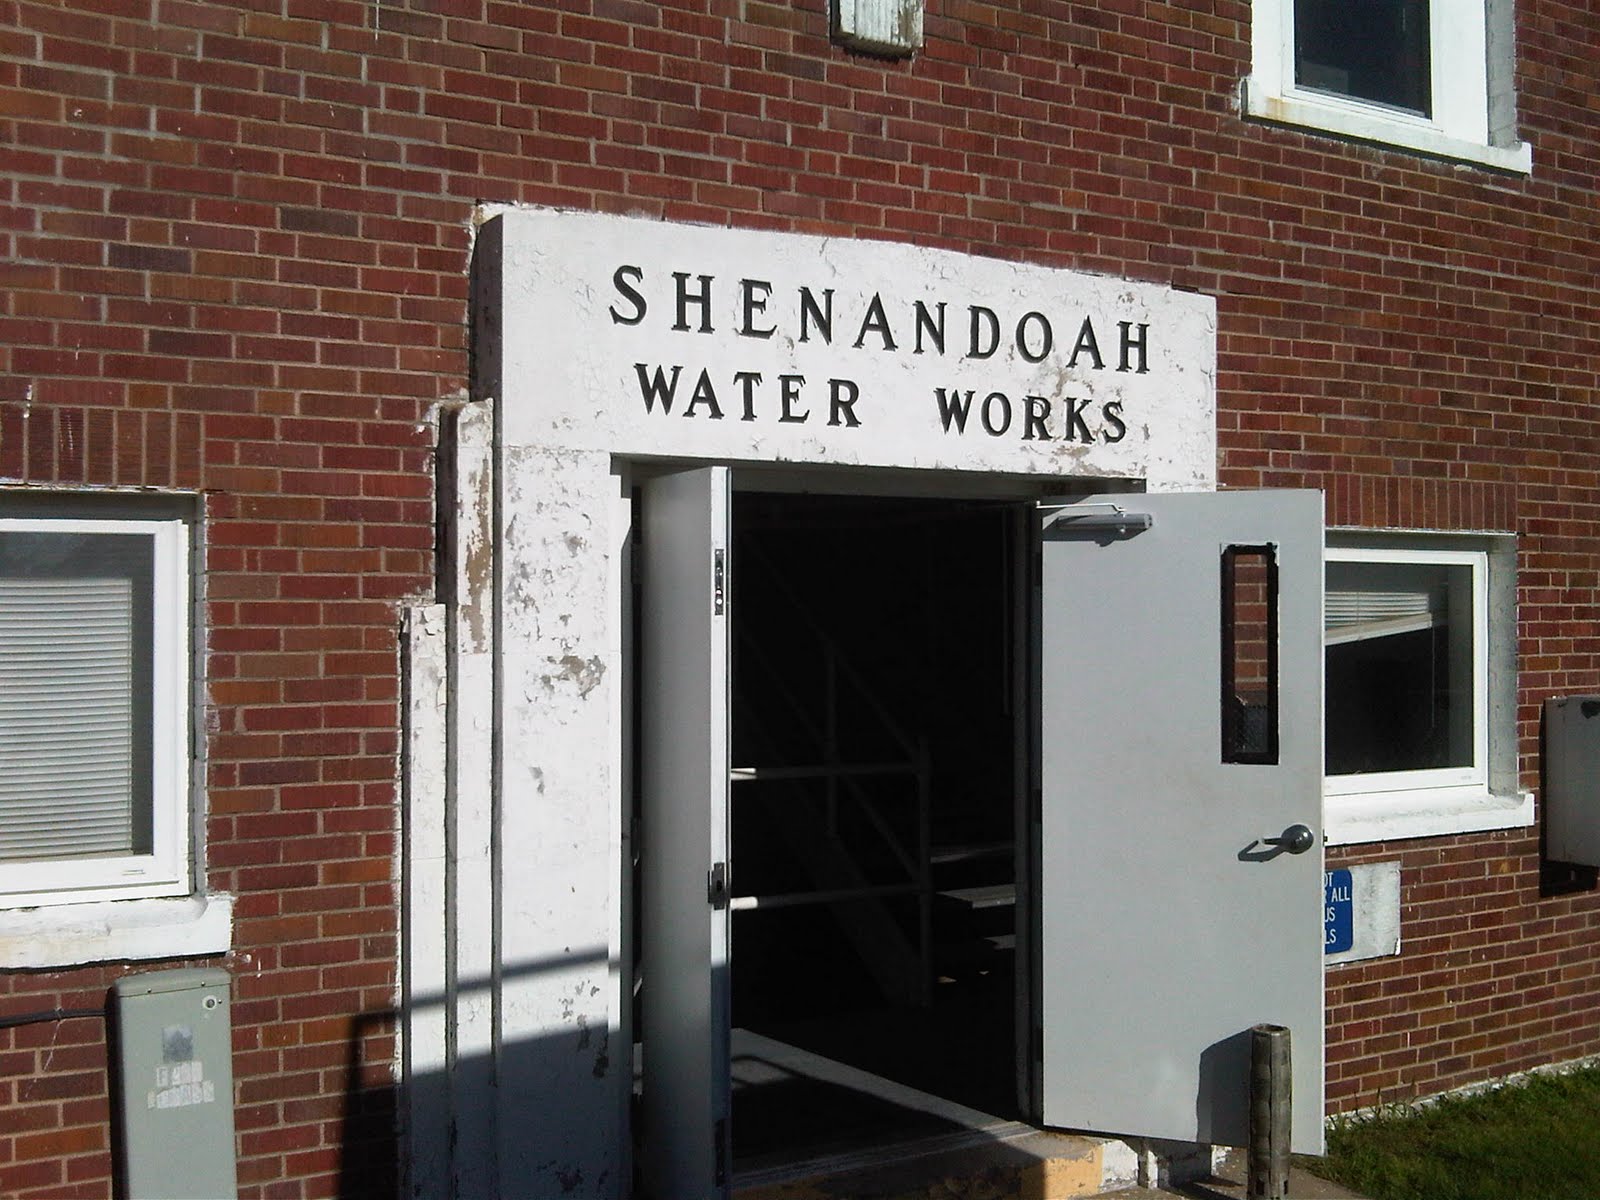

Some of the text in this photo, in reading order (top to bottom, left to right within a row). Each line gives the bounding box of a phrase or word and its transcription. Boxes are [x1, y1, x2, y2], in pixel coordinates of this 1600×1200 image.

[609, 265, 1150, 375] SHENANDOAH
[634, 362, 1128, 445] WATER WORKS
[1331, 886, 1350, 902] ALL
